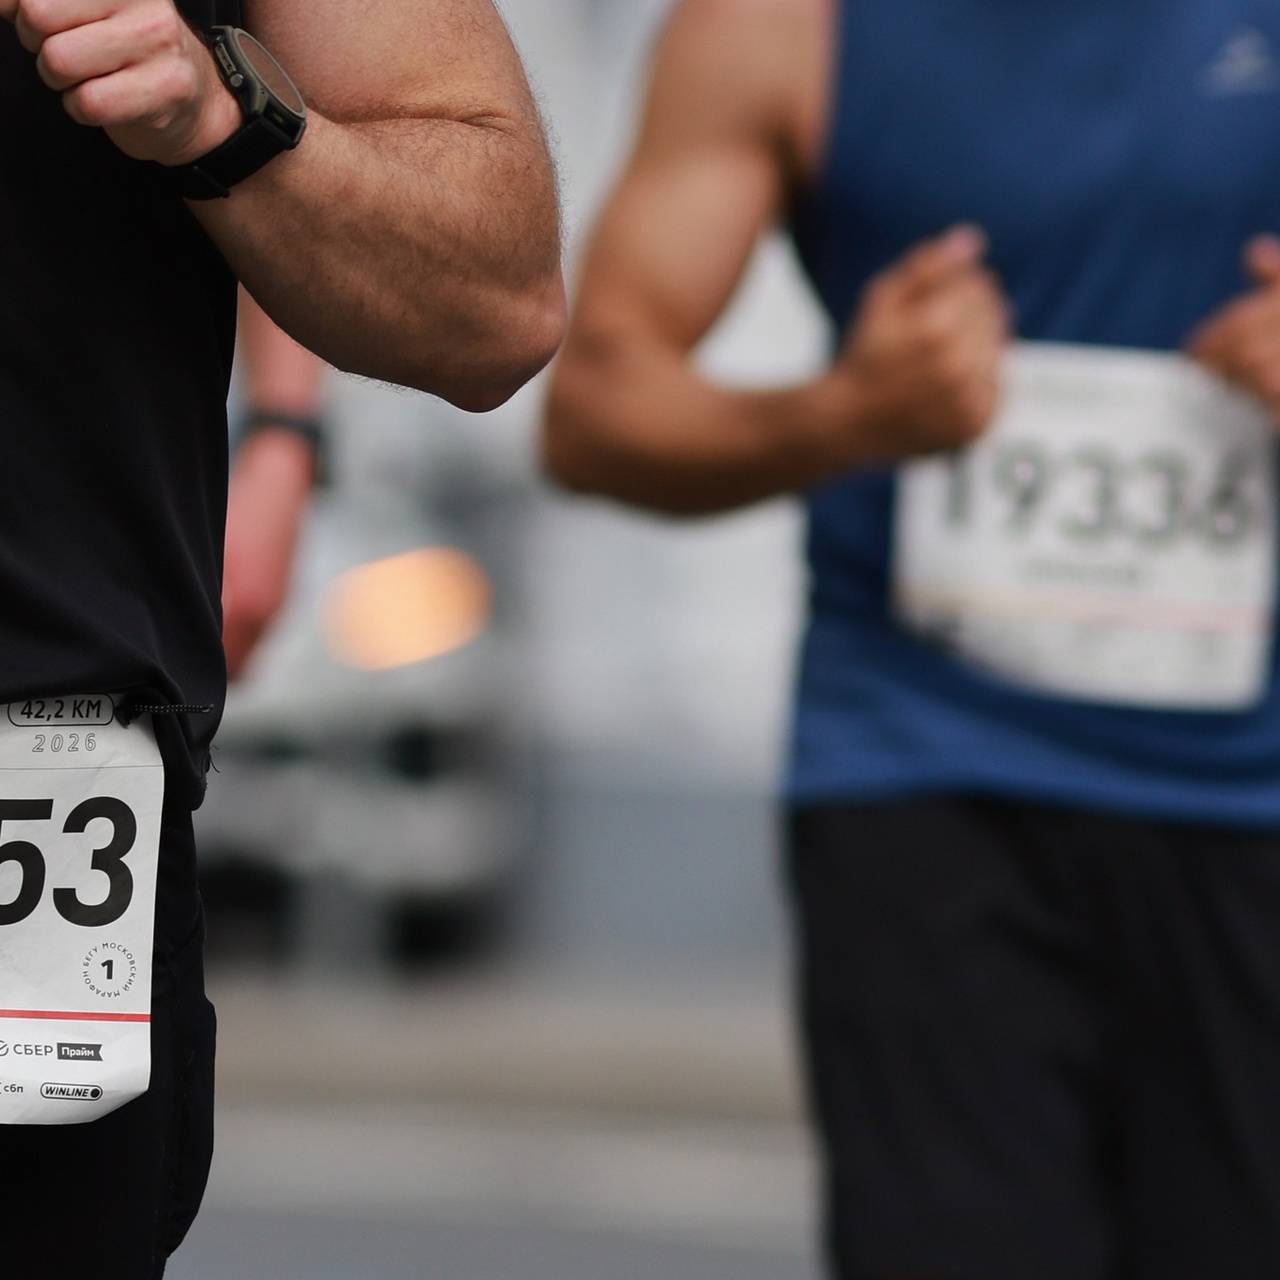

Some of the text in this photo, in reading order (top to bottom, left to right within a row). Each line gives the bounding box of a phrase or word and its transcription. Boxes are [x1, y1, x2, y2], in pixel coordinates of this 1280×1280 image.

[944, 438, 1258, 558] 19336
[20, 699, 65, 722] 42,2
[32, 733, 97, 752] 2026
[101, 959, 114, 980] 1
[13, 1043, 95, 1057] СБЕР Прайм
[44, 1085, 89, 1098] WINLINE
